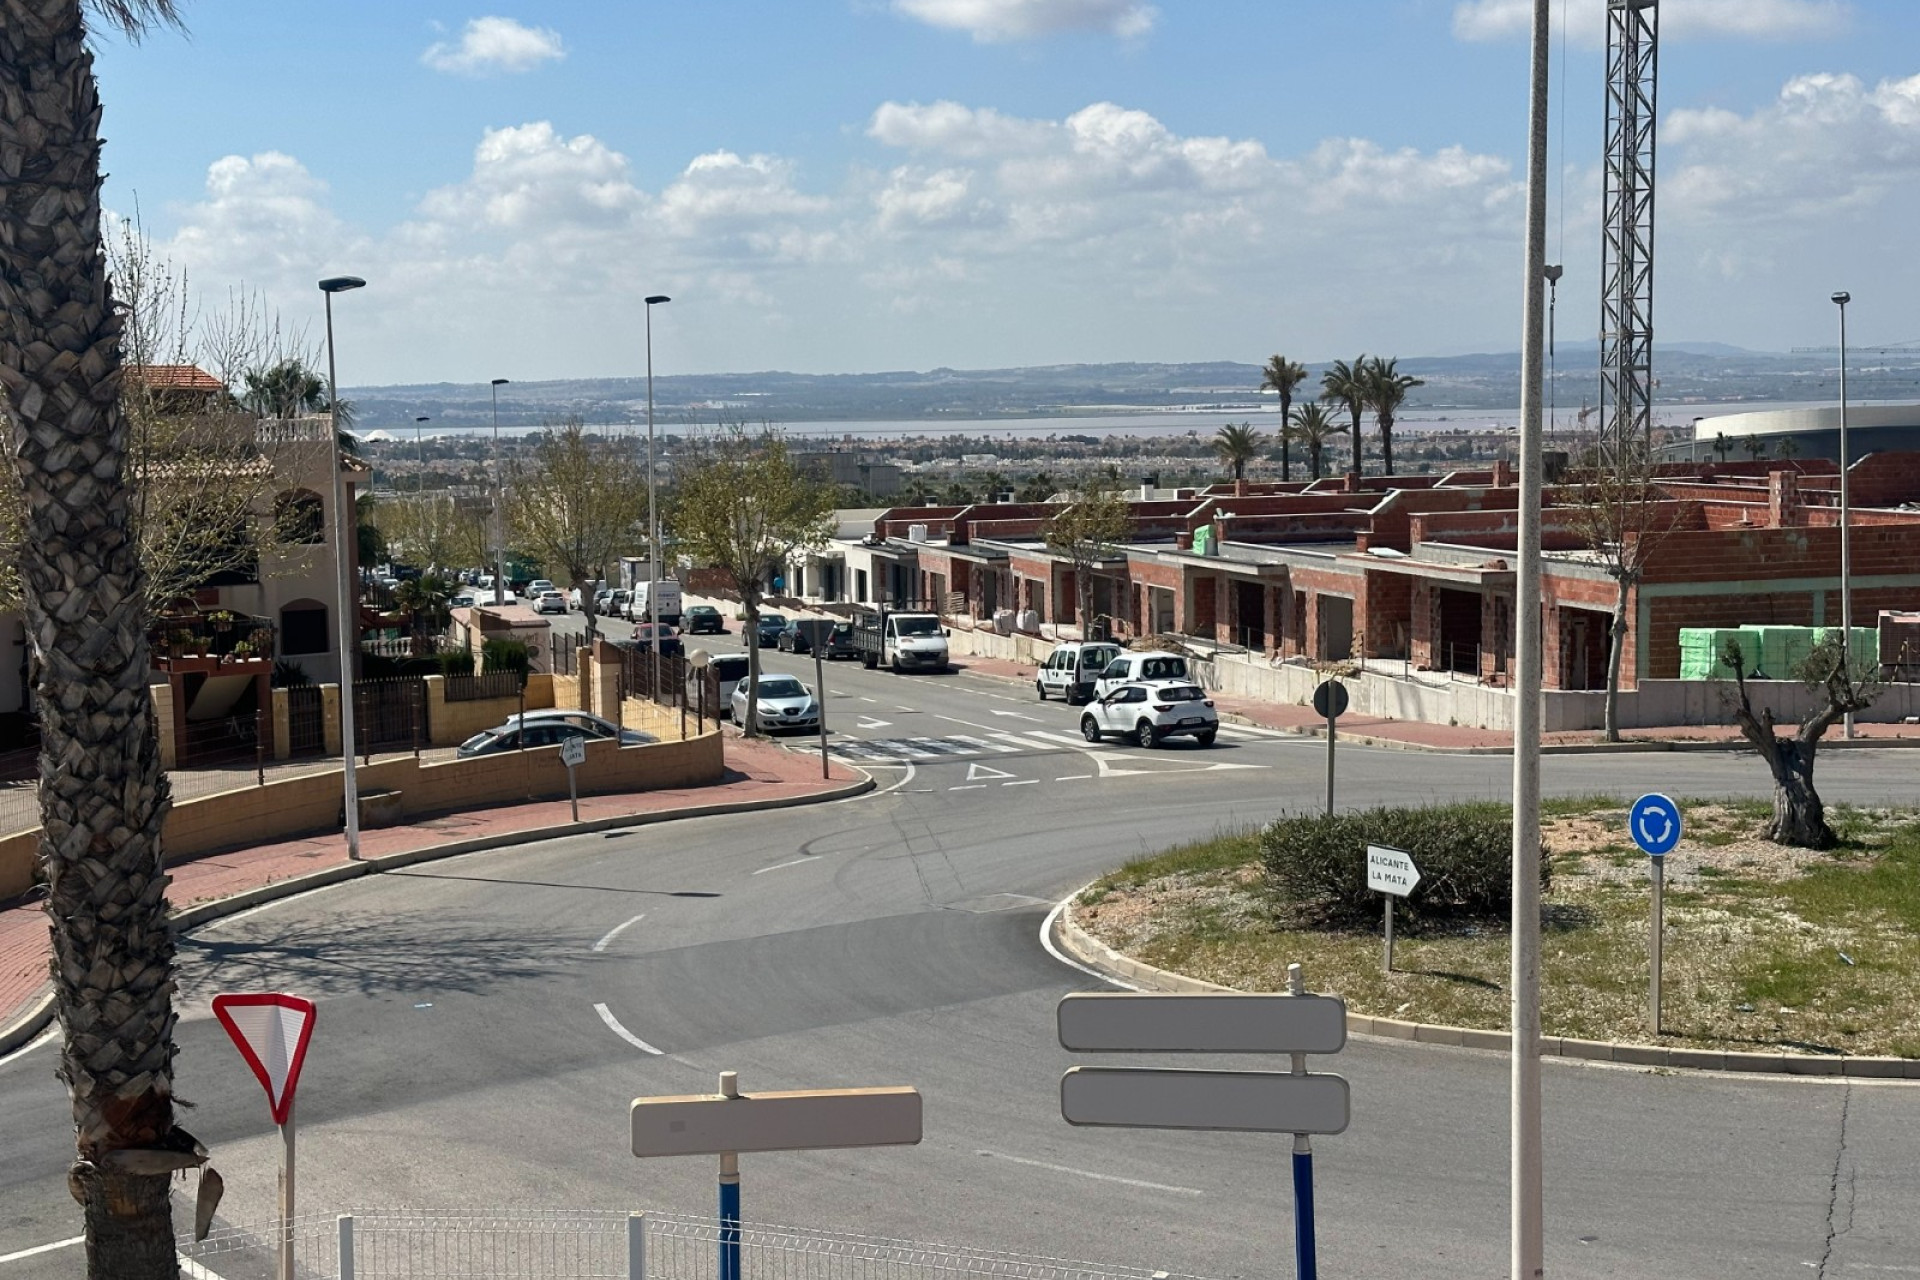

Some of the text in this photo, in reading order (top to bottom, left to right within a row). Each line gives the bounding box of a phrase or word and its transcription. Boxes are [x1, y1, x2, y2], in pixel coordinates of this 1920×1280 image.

[1370, 855, 1409, 871] ALICANTE
[1372, 871, 1408, 886] LA MATA
